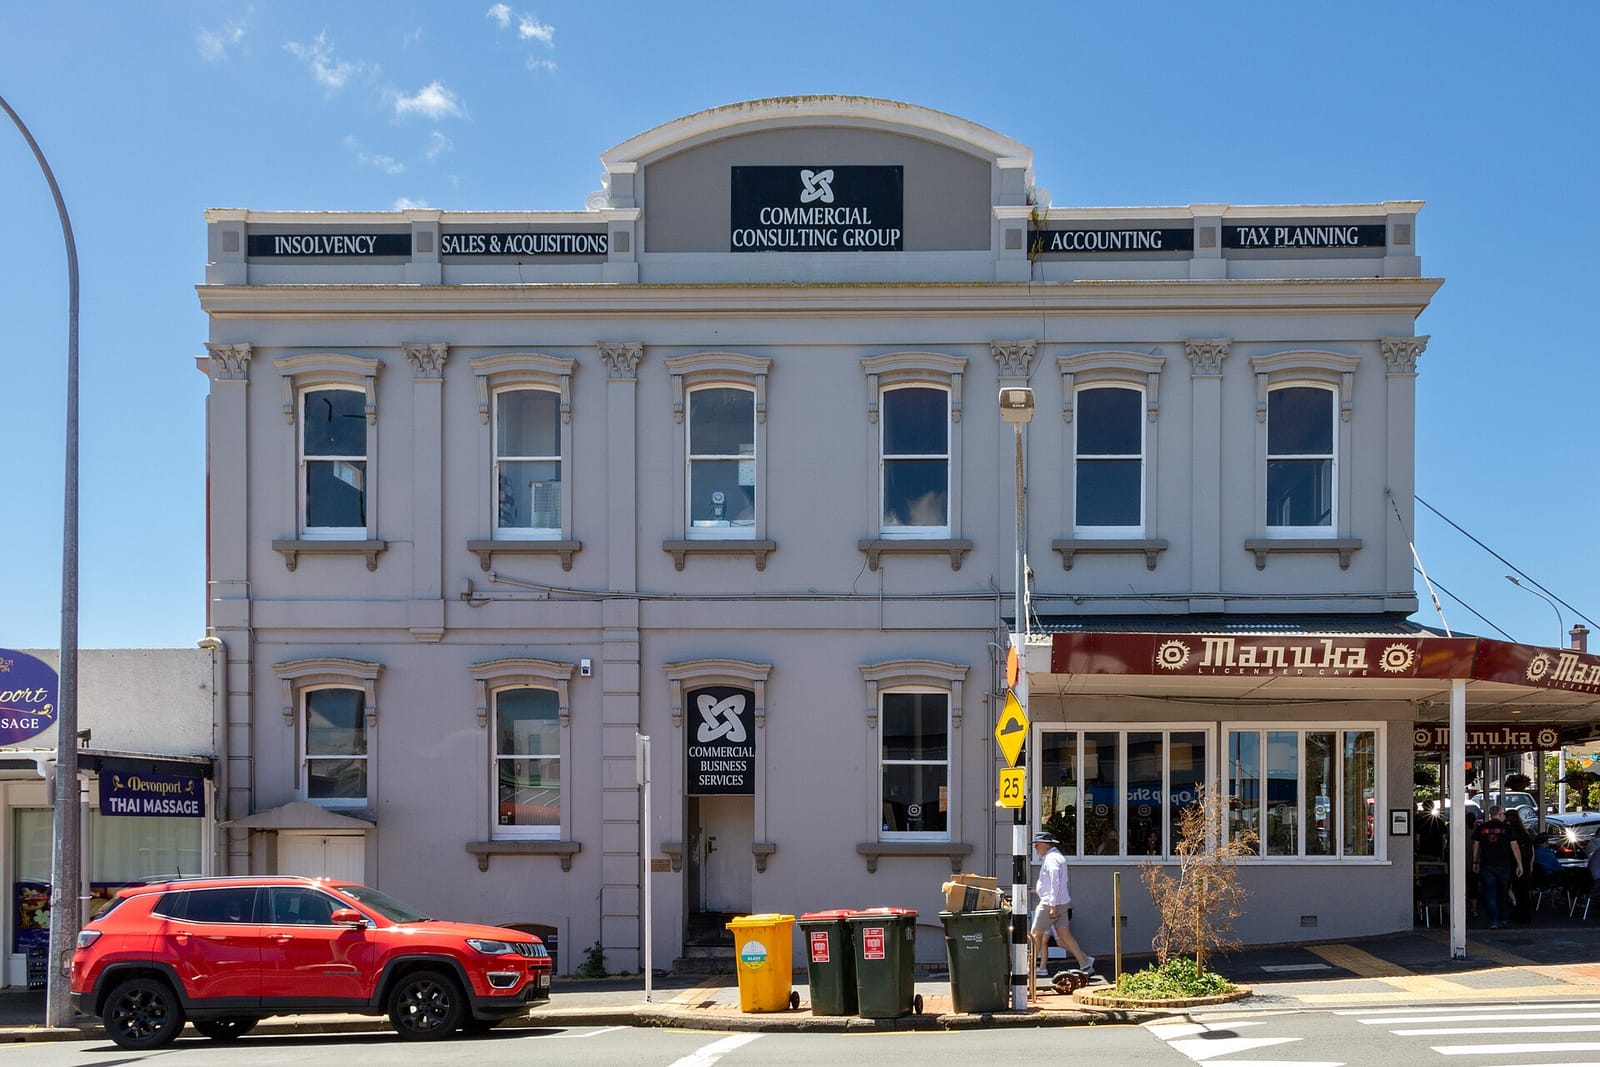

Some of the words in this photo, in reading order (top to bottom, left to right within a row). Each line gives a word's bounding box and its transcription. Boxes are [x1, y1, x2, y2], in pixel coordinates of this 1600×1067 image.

[759, 207, 872, 225] COMMERCIAL
[274, 235, 377, 254] INSOLVENCY
[441, 235, 486, 254] SALES
[489, 236, 501, 254] &
[503, 235, 607, 256] ACQUISITIONS
[732, 228, 838, 247] CONSULTING
[842, 228, 901, 247] GROUP
[1050, 231, 1163, 251] ACCOUNTING
[1236, 227, 1270, 246] TAX
[1274, 226, 1359, 246] PLANNING
[1199, 637, 1369, 669] Manuka
[1, 718, 40, 729] SAGE
[1434, 727, 1533, 745] Mnuka
[688, 746, 755, 758] COMMERCIAL
[700, 760, 747, 772] BUSINESS
[127, 775, 183, 796] Devonport
[698, 774, 744, 786] SERVICES
[1003, 777, 1020, 799] 25
[109, 797, 140, 813] THAI
[143, 797, 199, 814] MASSAGE
